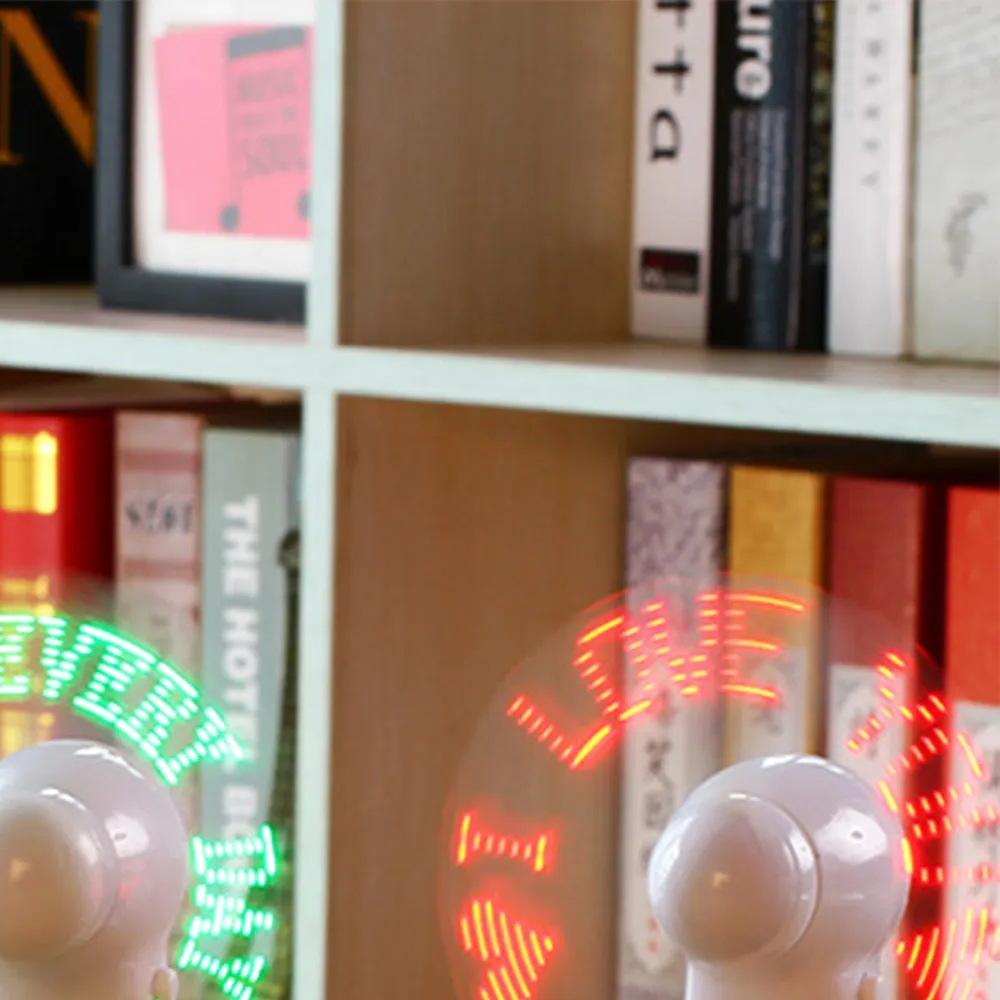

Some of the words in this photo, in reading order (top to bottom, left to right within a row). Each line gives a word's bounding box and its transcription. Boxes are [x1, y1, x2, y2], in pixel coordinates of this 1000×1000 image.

[222, 496, 259, 596] THE
[457, 812, 550, 874] I
[506, 592, 805, 769] LOVE
